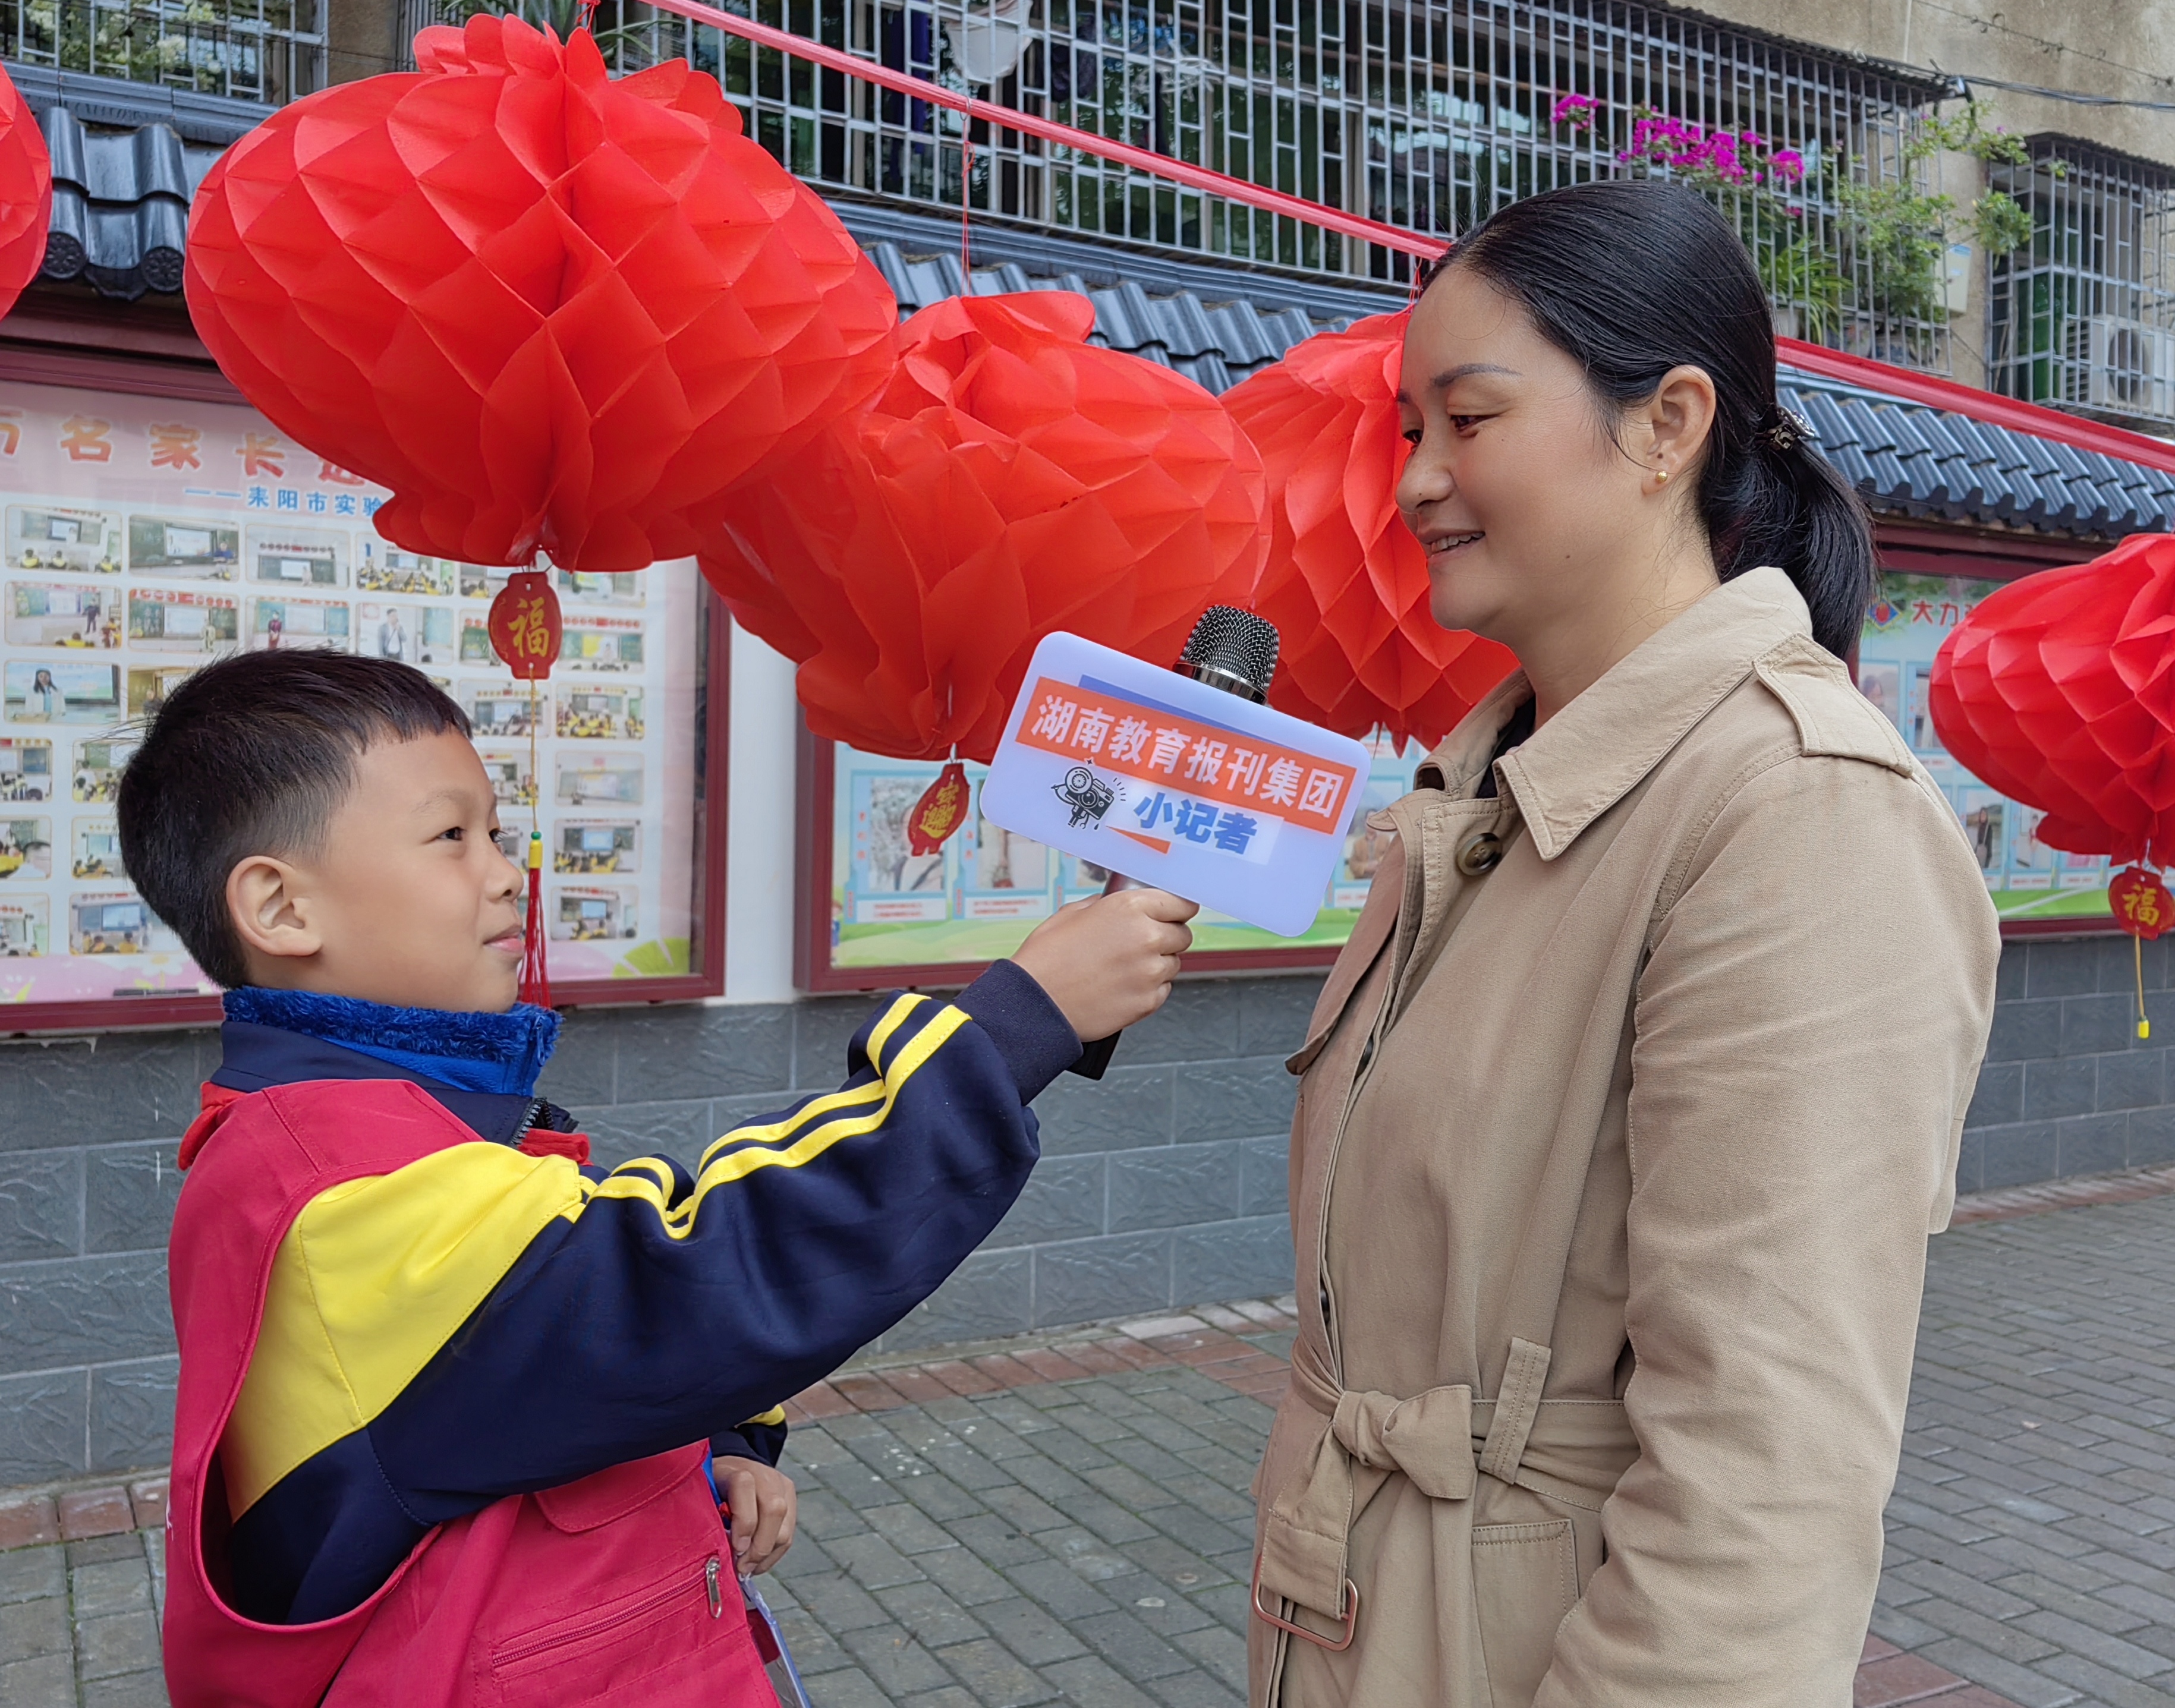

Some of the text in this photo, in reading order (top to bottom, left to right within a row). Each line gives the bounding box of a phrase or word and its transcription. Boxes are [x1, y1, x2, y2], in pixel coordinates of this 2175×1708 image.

[507, 596, 550, 658] 福
[1912, 600, 1975, 626] 大力
[1031, 694, 1344, 819] 湖南教育报刊集团
[1133, 792, 1258, 855] 小记者
[2122, 883, 2160, 927] 福
